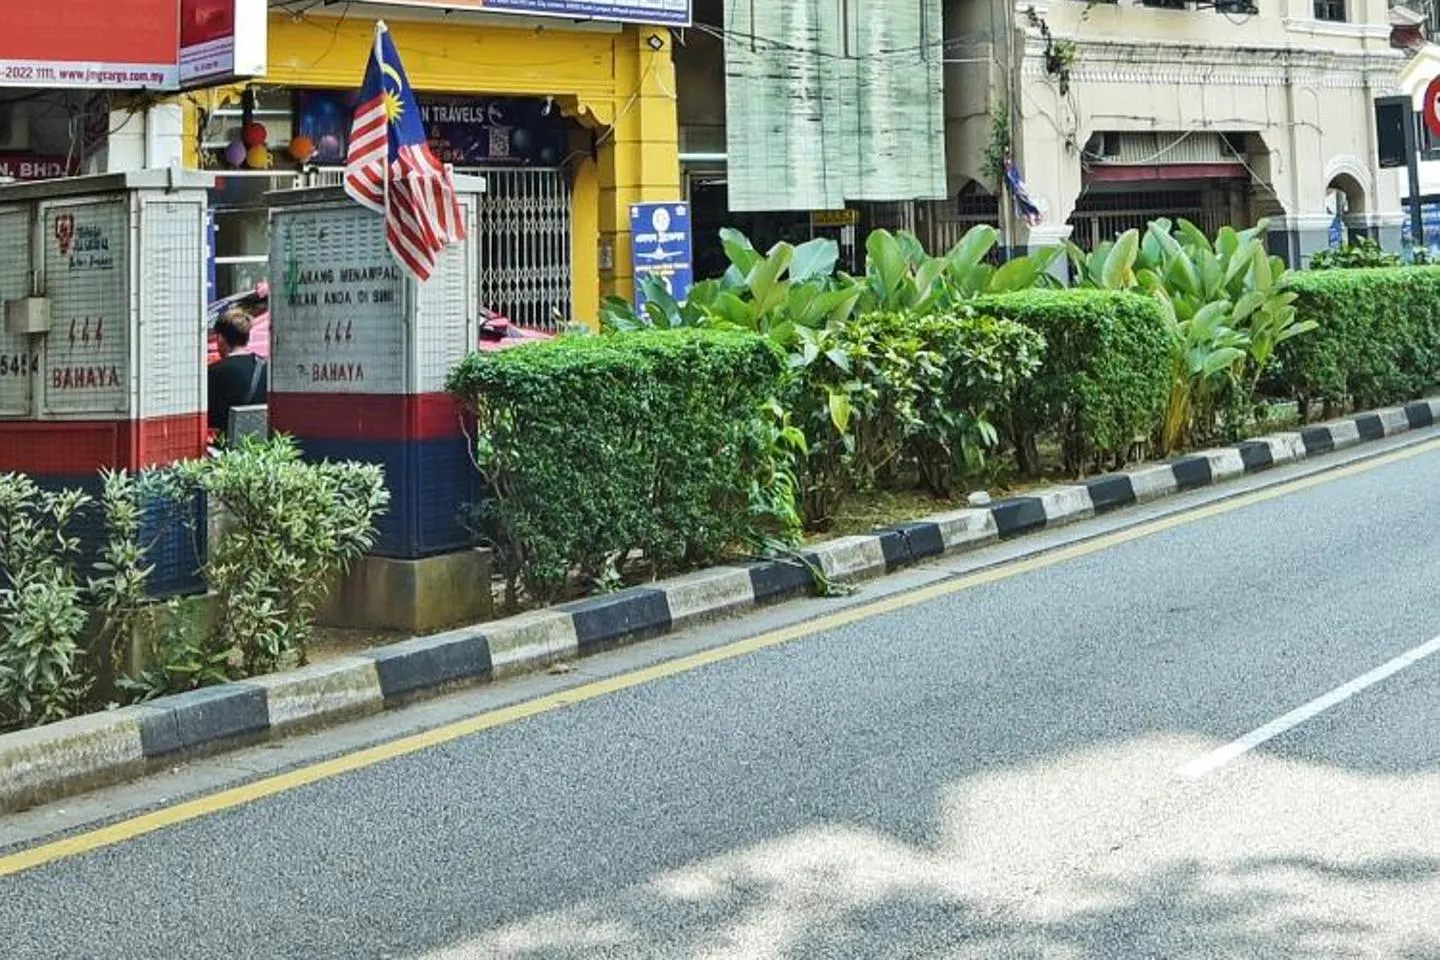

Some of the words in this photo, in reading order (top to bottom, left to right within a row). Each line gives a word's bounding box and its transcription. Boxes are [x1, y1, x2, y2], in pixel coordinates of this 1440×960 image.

[434, 105, 485, 124] TRAVELS
[52, 366, 119, 389] BAHAYA
[312, 363, 364, 381] BAHAYA
